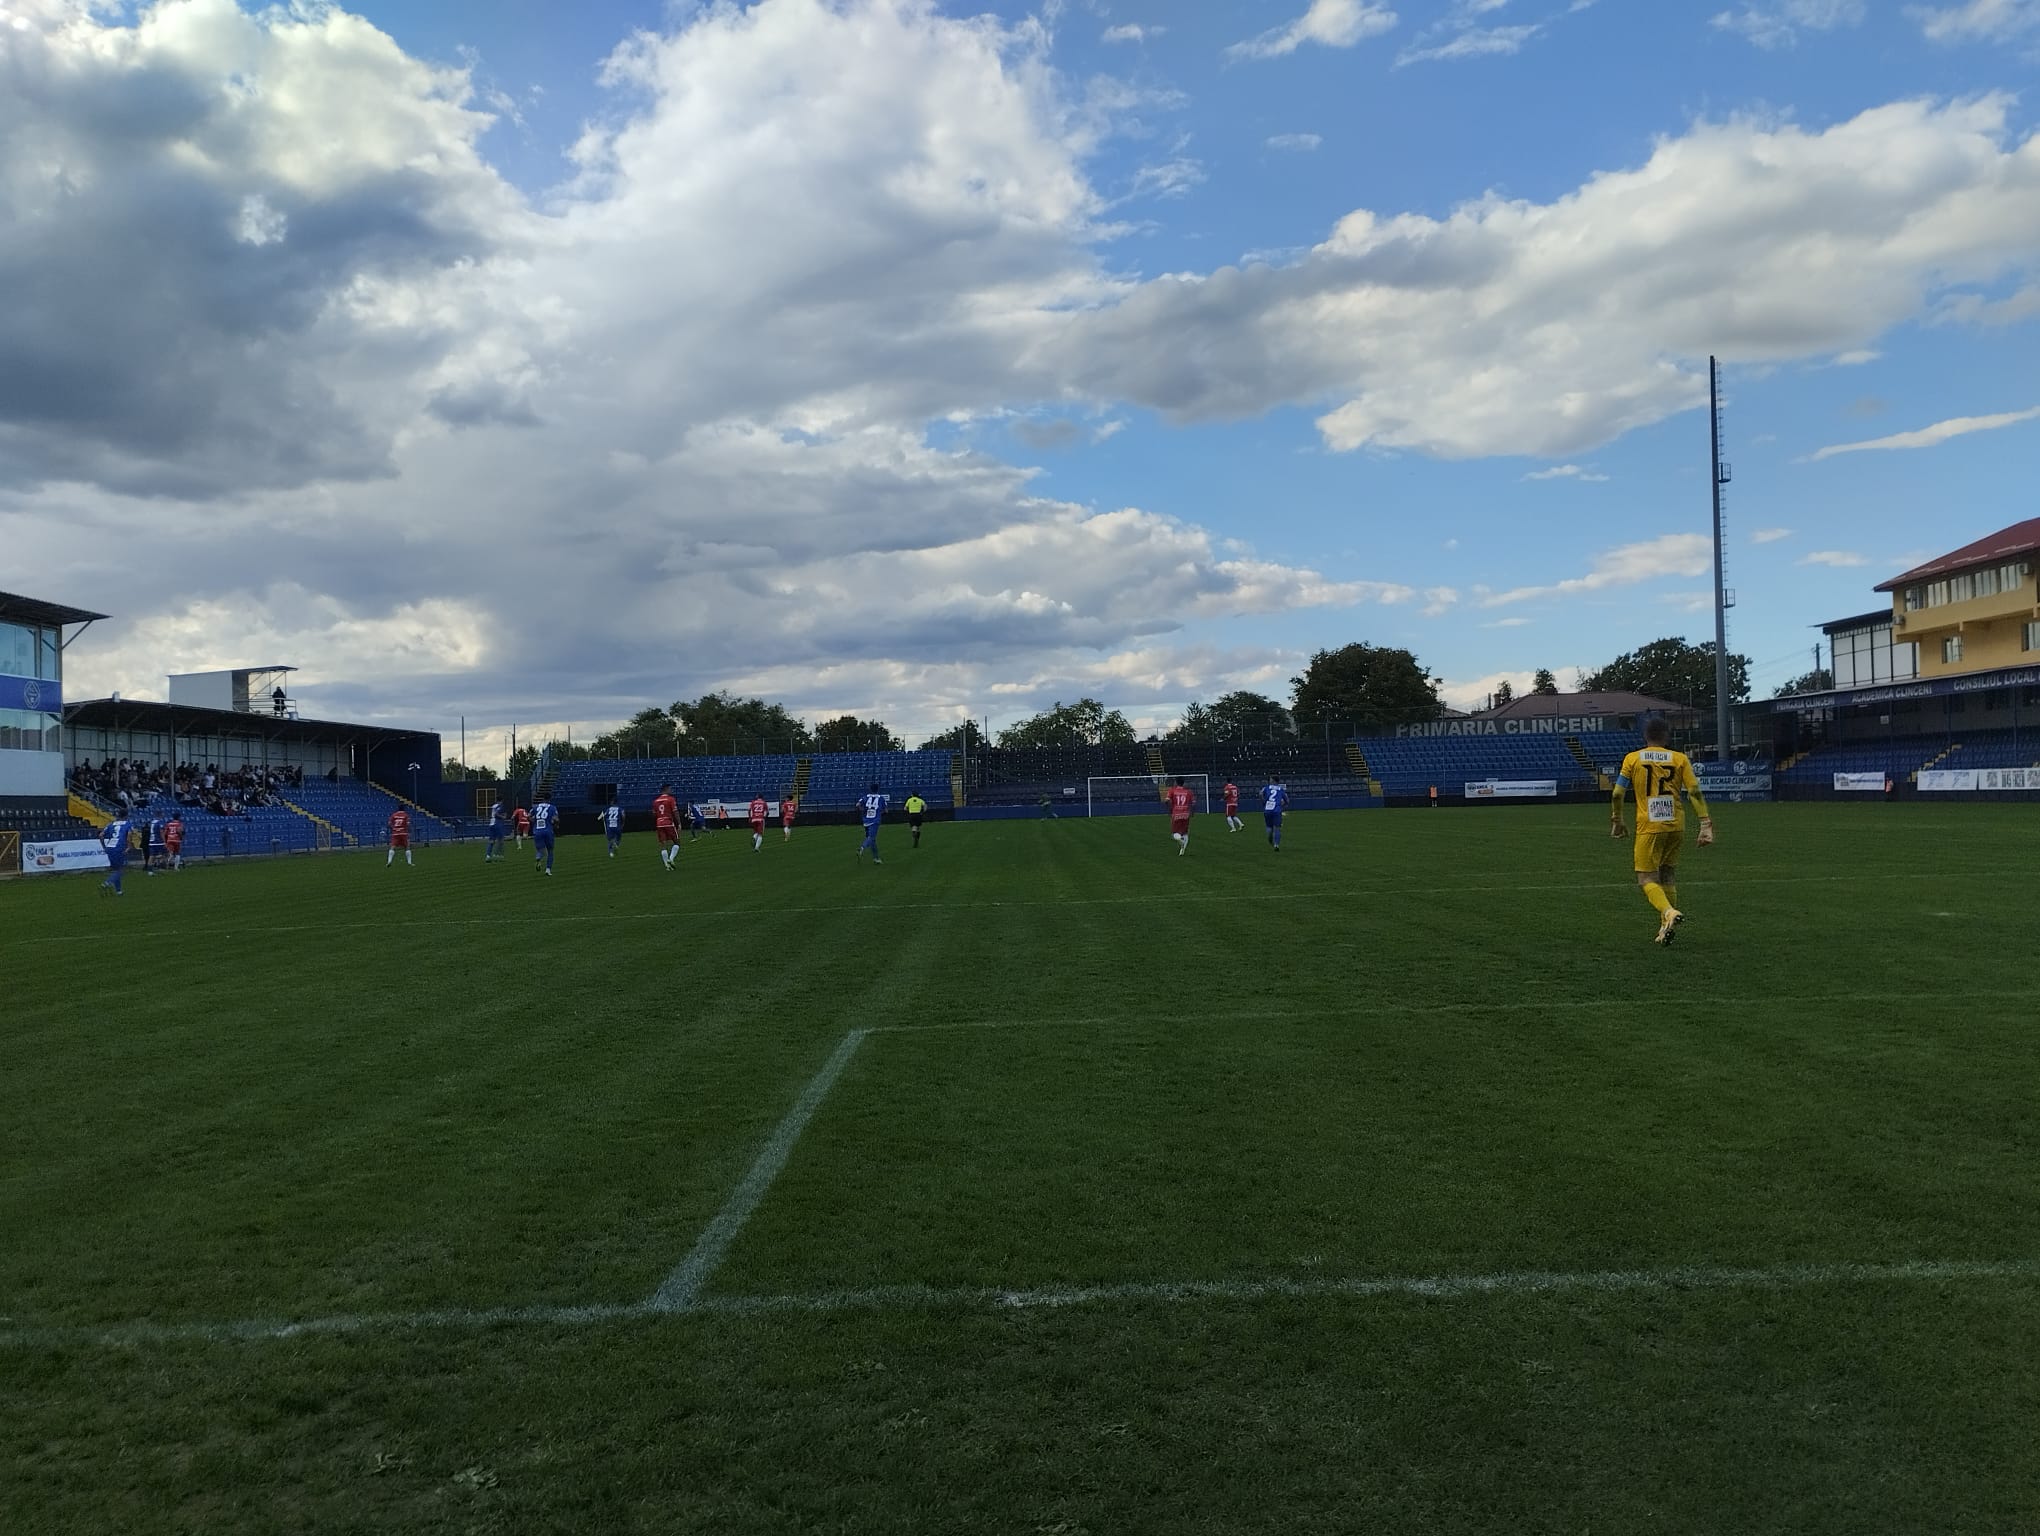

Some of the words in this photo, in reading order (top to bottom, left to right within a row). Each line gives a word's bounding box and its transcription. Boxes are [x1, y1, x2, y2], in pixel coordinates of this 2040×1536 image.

[1953, 674, 2002, 691] CONSILIUL
[2003, 671, 2036, 685] LOCAL
[1851, 688, 1894, 704] ACADEMICA
[1895, 683, 1933, 698] CLINCENI
[1805, 696, 1836, 709] CLINCENI
[1395, 720, 1499, 737] PRIMARIA
[1504, 717, 1604, 734] CLINCENI
[1642, 764, 1675, 797] 12
[1176, 795, 1187, 806] 19
[1269, 790, 1277, 802] 2
[659, 804, 665, 815] 9
[753, 804, 764, 812] 23
[866, 797, 879, 810] 44
[536, 806, 549, 819] 26
[608, 807, 619, 820] 22
